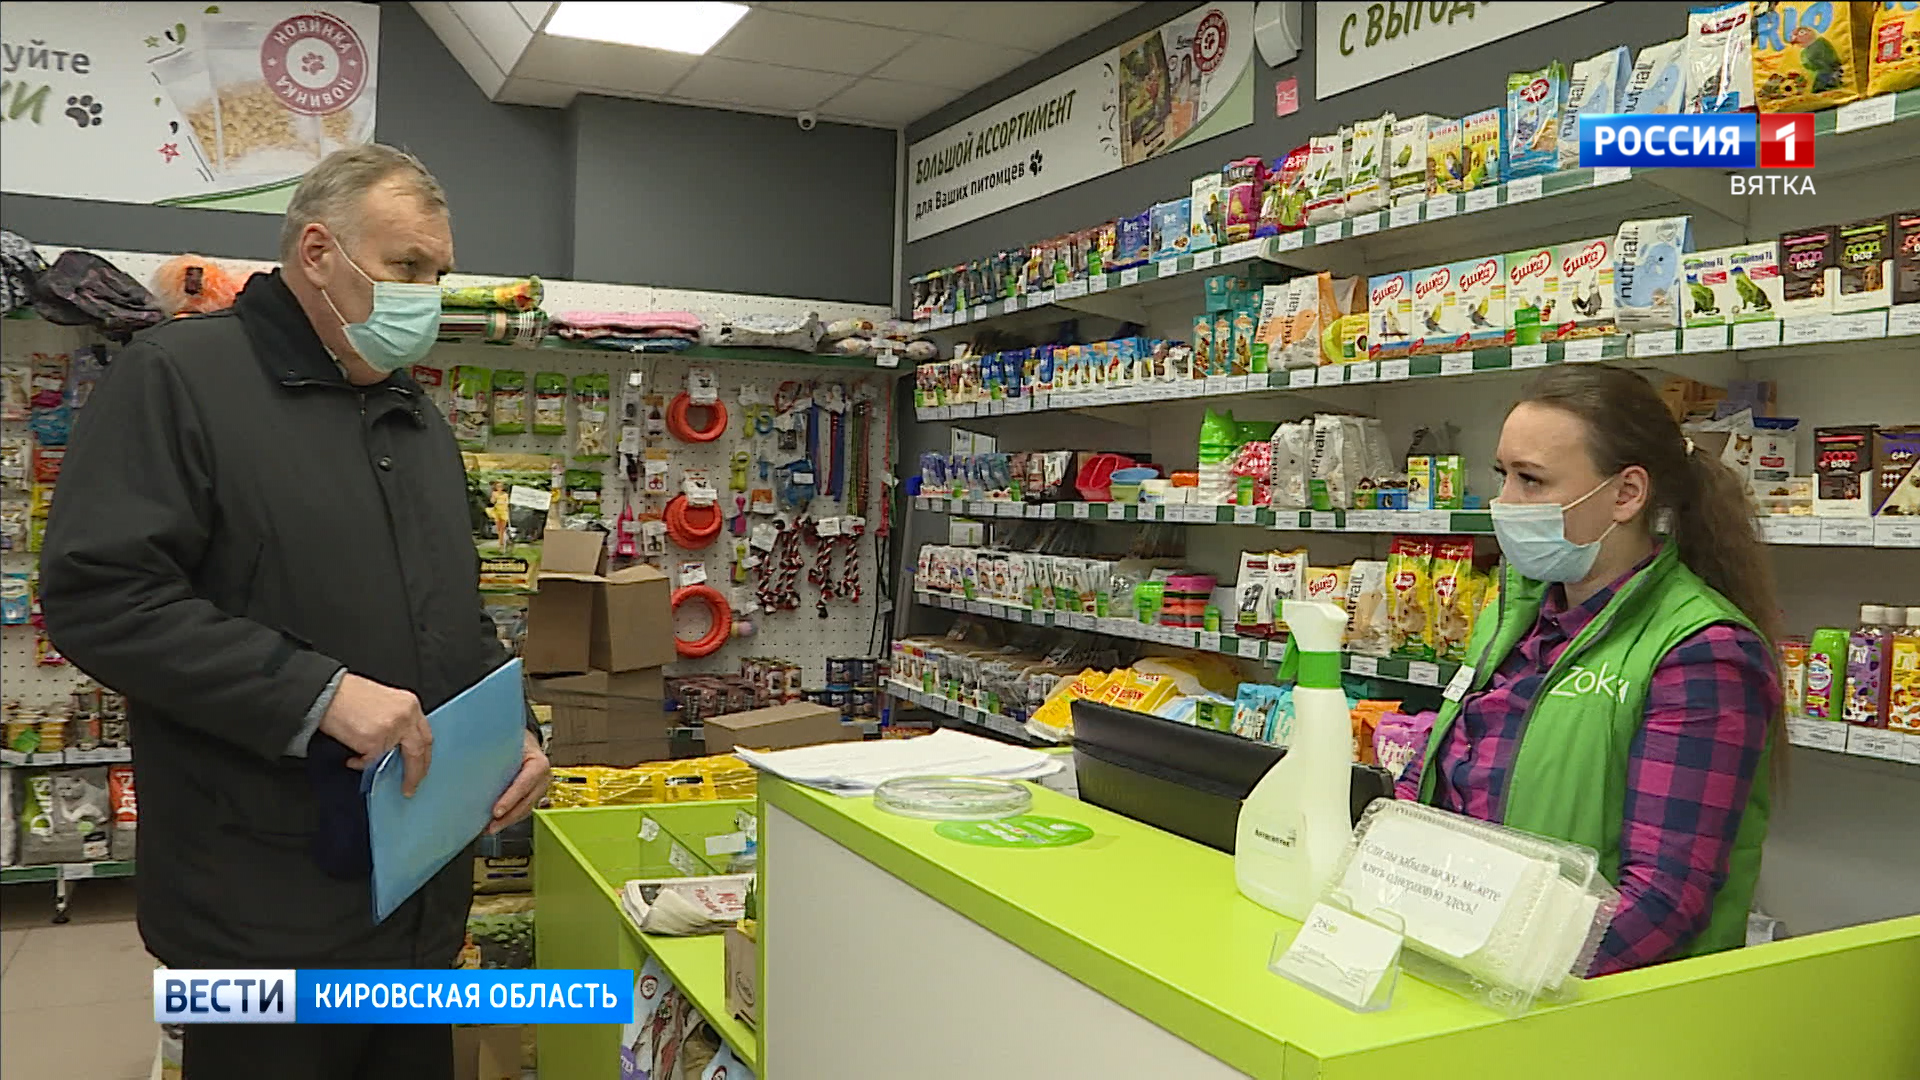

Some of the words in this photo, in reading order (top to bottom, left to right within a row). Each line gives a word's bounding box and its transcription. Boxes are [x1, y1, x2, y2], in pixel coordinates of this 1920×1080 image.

[275, 19, 353, 54] НОВИНКА
[1340, 13, 1357, 56] С
[1756, 2, 1833, 53] RIO
[276, 75, 353, 107] НОВИНКА
[915, 131, 973, 186] БОЛЬШОЙ
[975, 89, 1077, 157] АССОРТИМЕНТ
[915, 198, 933, 221] для
[935, 185, 969, 211] Ваших
[971, 161, 1025, 195] питомцев
[1399, 857, 1431, 876] забыли
